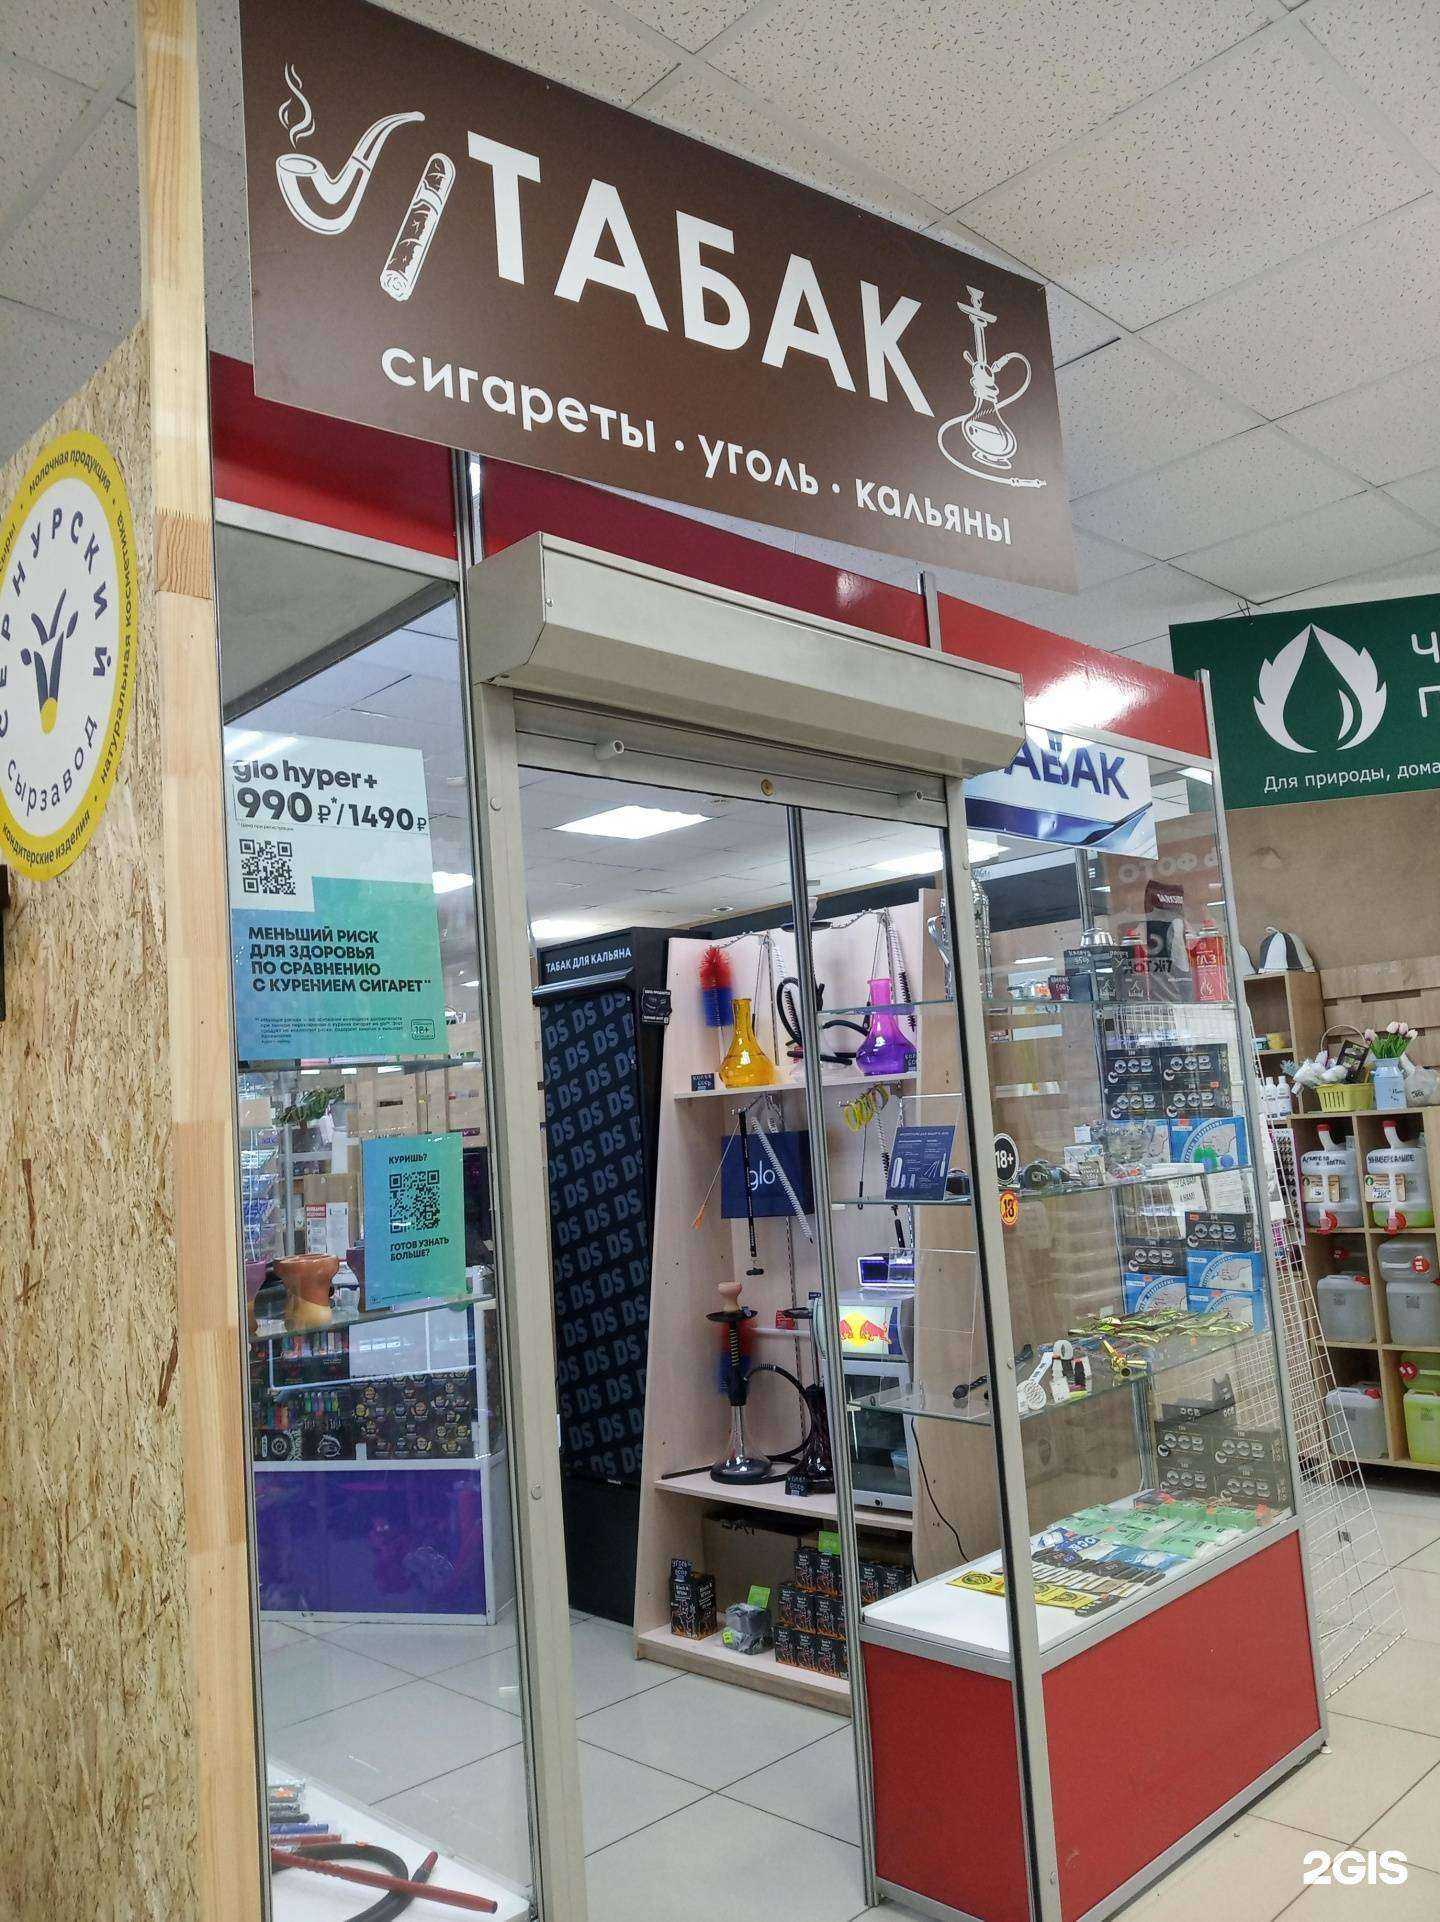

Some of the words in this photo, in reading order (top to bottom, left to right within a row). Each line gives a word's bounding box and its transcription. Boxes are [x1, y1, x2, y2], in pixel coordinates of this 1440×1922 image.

[467, 131, 934, 417] ТАБАК
[381, 346, 656, 453] сигареты
[699, 434, 819, 495] уголь
[856, 478, 1012, 546] кальяны
[29, 450, 69, 496] молочная
[70, 448, 111, 493] продукция
[100, 635, 132, 785] натуральная
[117, 511, 132, 627] косметика
[8, 715, 98, 816] сырзавод
[283, 760, 377, 790] hyper+
[1264, 775, 1299, 794] Для
[1305, 768, 1391, 787] природы,
[55, 809, 91, 857] изделия
[249, 926, 334, 942] МЕНЬШИЙ
[337, 929, 380, 944] РИСК
[250, 944, 286, 960] ДЛЯ
[290, 945, 375, 960] ЗДОРОВЬЯ
[546, 961, 572, 973] ТАБАК
[572, 957, 590, 970] ДЛЯ
[590, 947, 632, 965] КАЛЬЯНА
[251, 961, 277, 975] ПО
[280, 961, 381, 976] СРАВНЕНИЮ
[252, 978, 266, 992] С
[270, 979, 356, 992] КУРЕНИЕМ
[572, 1002, 596, 1033] DS
[545, 1019, 568, 1050] DS
[593, 1023, 618, 1056] DS
[565, 1040, 589, 1071] DS
[1114, 1058, 1154, 1074] OCB
[1170, 1055, 1212, 1072] OCB
[585, 1063, 610, 1094] DS
[558, 1079, 581, 1110] DS
[607, 1085, 633, 1118] DS
[1116, 1094, 1156, 1110] OCB
[1173, 1092, 1216, 1109] OCB
[551, 1116, 575, 1147] DS
[578, 1101, 603, 1132] DS
[599, 1124, 625, 1155] DS
[388, 1153, 428, 1165] КУРИШЬ?
[571, 1140, 596, 1171] DS
[994, 1149, 1013, 1169] 18+
[592, 1164, 618, 1195] DS
[748, 1161, 776, 1191] glo
[564, 1178, 588, 1209] DS
[614, 1188, 640, 1220] DS
[1003, 1198, 1016, 1218] 18
[557, 1216, 580, 1246] DS
[584, 1202, 610, 1233] DS
[1194, 1222, 1239, 1241] OCB
[390, 1249, 431, 1262] БОЛЬШЕ?
[391, 1240, 418, 1252] ГОТОВ
[419, 1238, 450, 1249] УЗНАТЬ
[577, 1242, 602, 1272] DS
[606, 1229, 632, 1260] DS
[1133, 1248, 1175, 1265] OCB
[570, 1279, 594, 1309] DS
[600, 1266, 625, 1298] DS
[622, 1295, 648, 1326] DS
[1163, 1433, 1205, 1452] OCB
[1222, 1439, 1266, 1459] OCB
[1166, 1470, 1208, 1489] OCB
